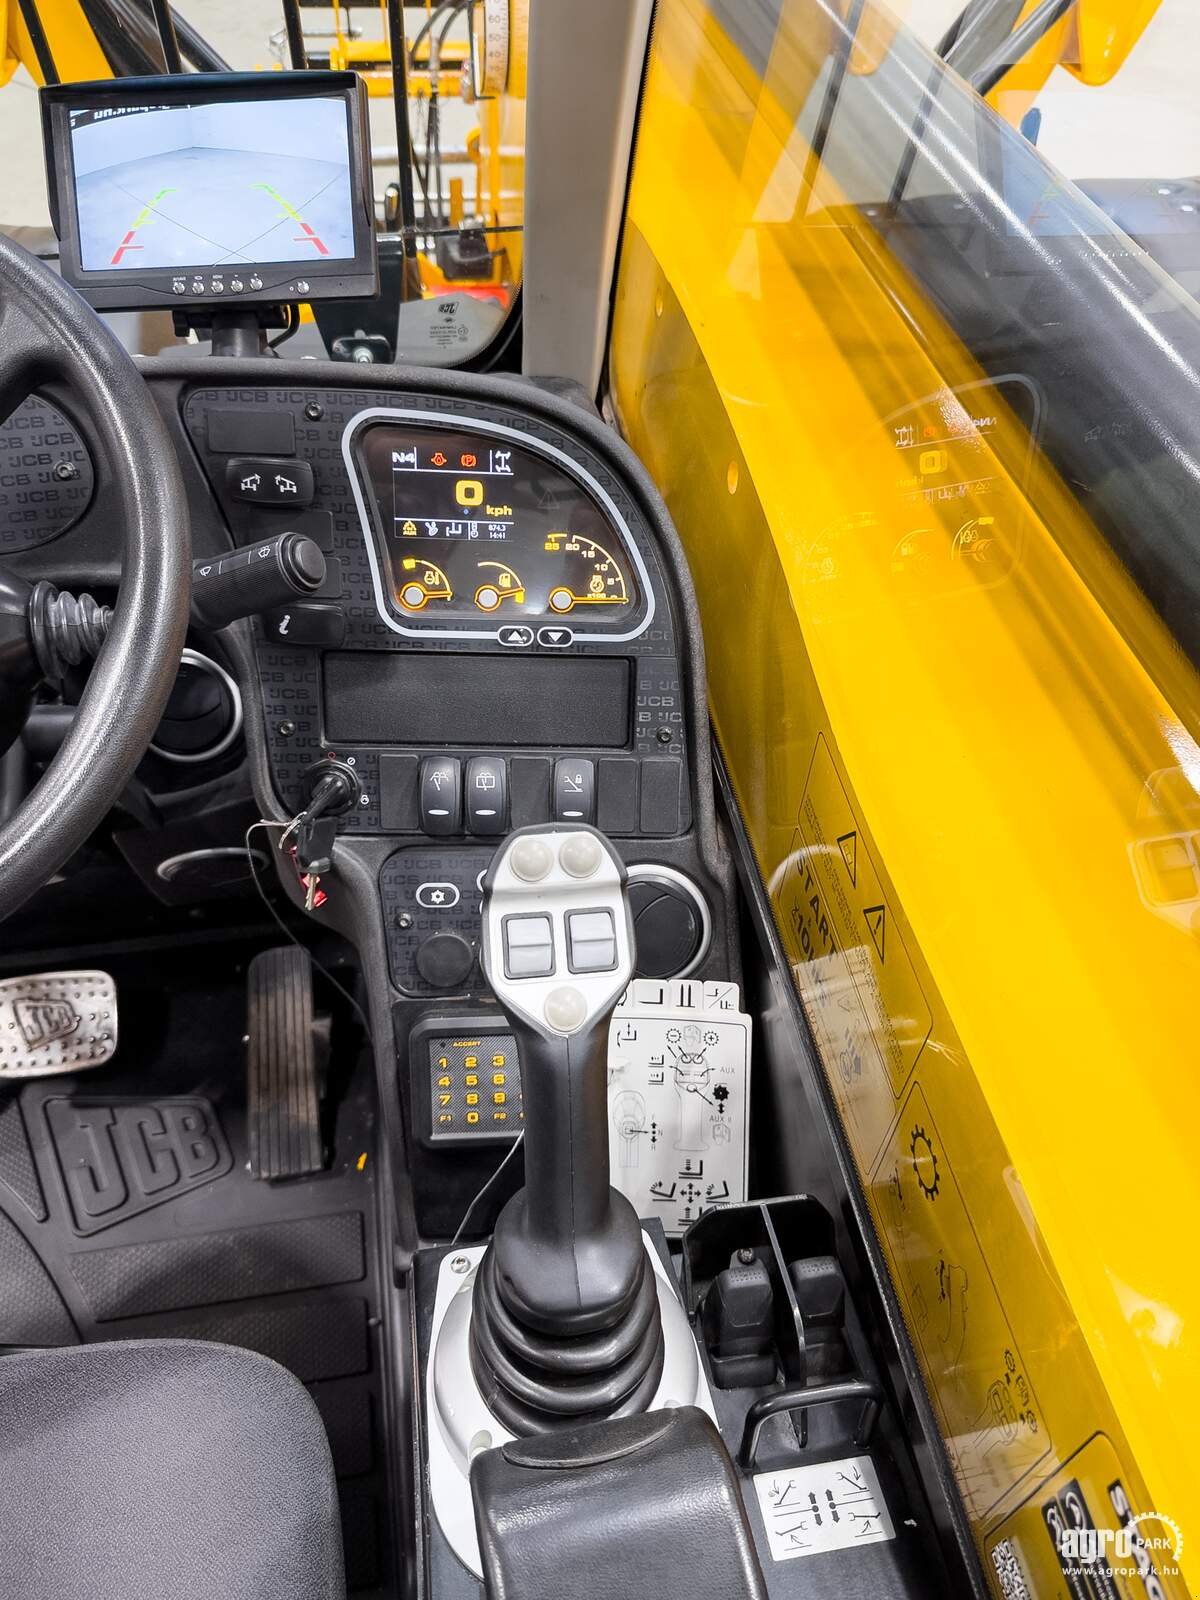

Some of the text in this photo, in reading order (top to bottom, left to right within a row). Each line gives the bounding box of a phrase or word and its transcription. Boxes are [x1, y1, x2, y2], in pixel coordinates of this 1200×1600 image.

[31, 432, 75, 447] JCB
[8, 453, 53, 468] JCB
[392, 452, 415, 463] N4
[15, 489, 60, 504] JCB
[455, 480, 484, 506] 0
[486, 505, 513, 517] kph
[544, 542, 580, 551] 25 20
[581, 550, 596, 558] 15
[594, 563, 609, 571] 10
[25, 1003, 75, 1043] JCB
[439, 1055, 505, 1069] 1 2 3
[719, 1066, 736, 1074] AUX
[438, 1073, 505, 1087] 4 5 6
[439, 1092, 506, 1106] 7 8 9
[468, 1111, 479, 1123] 0
[66, 1102, 222, 1218] JCB
